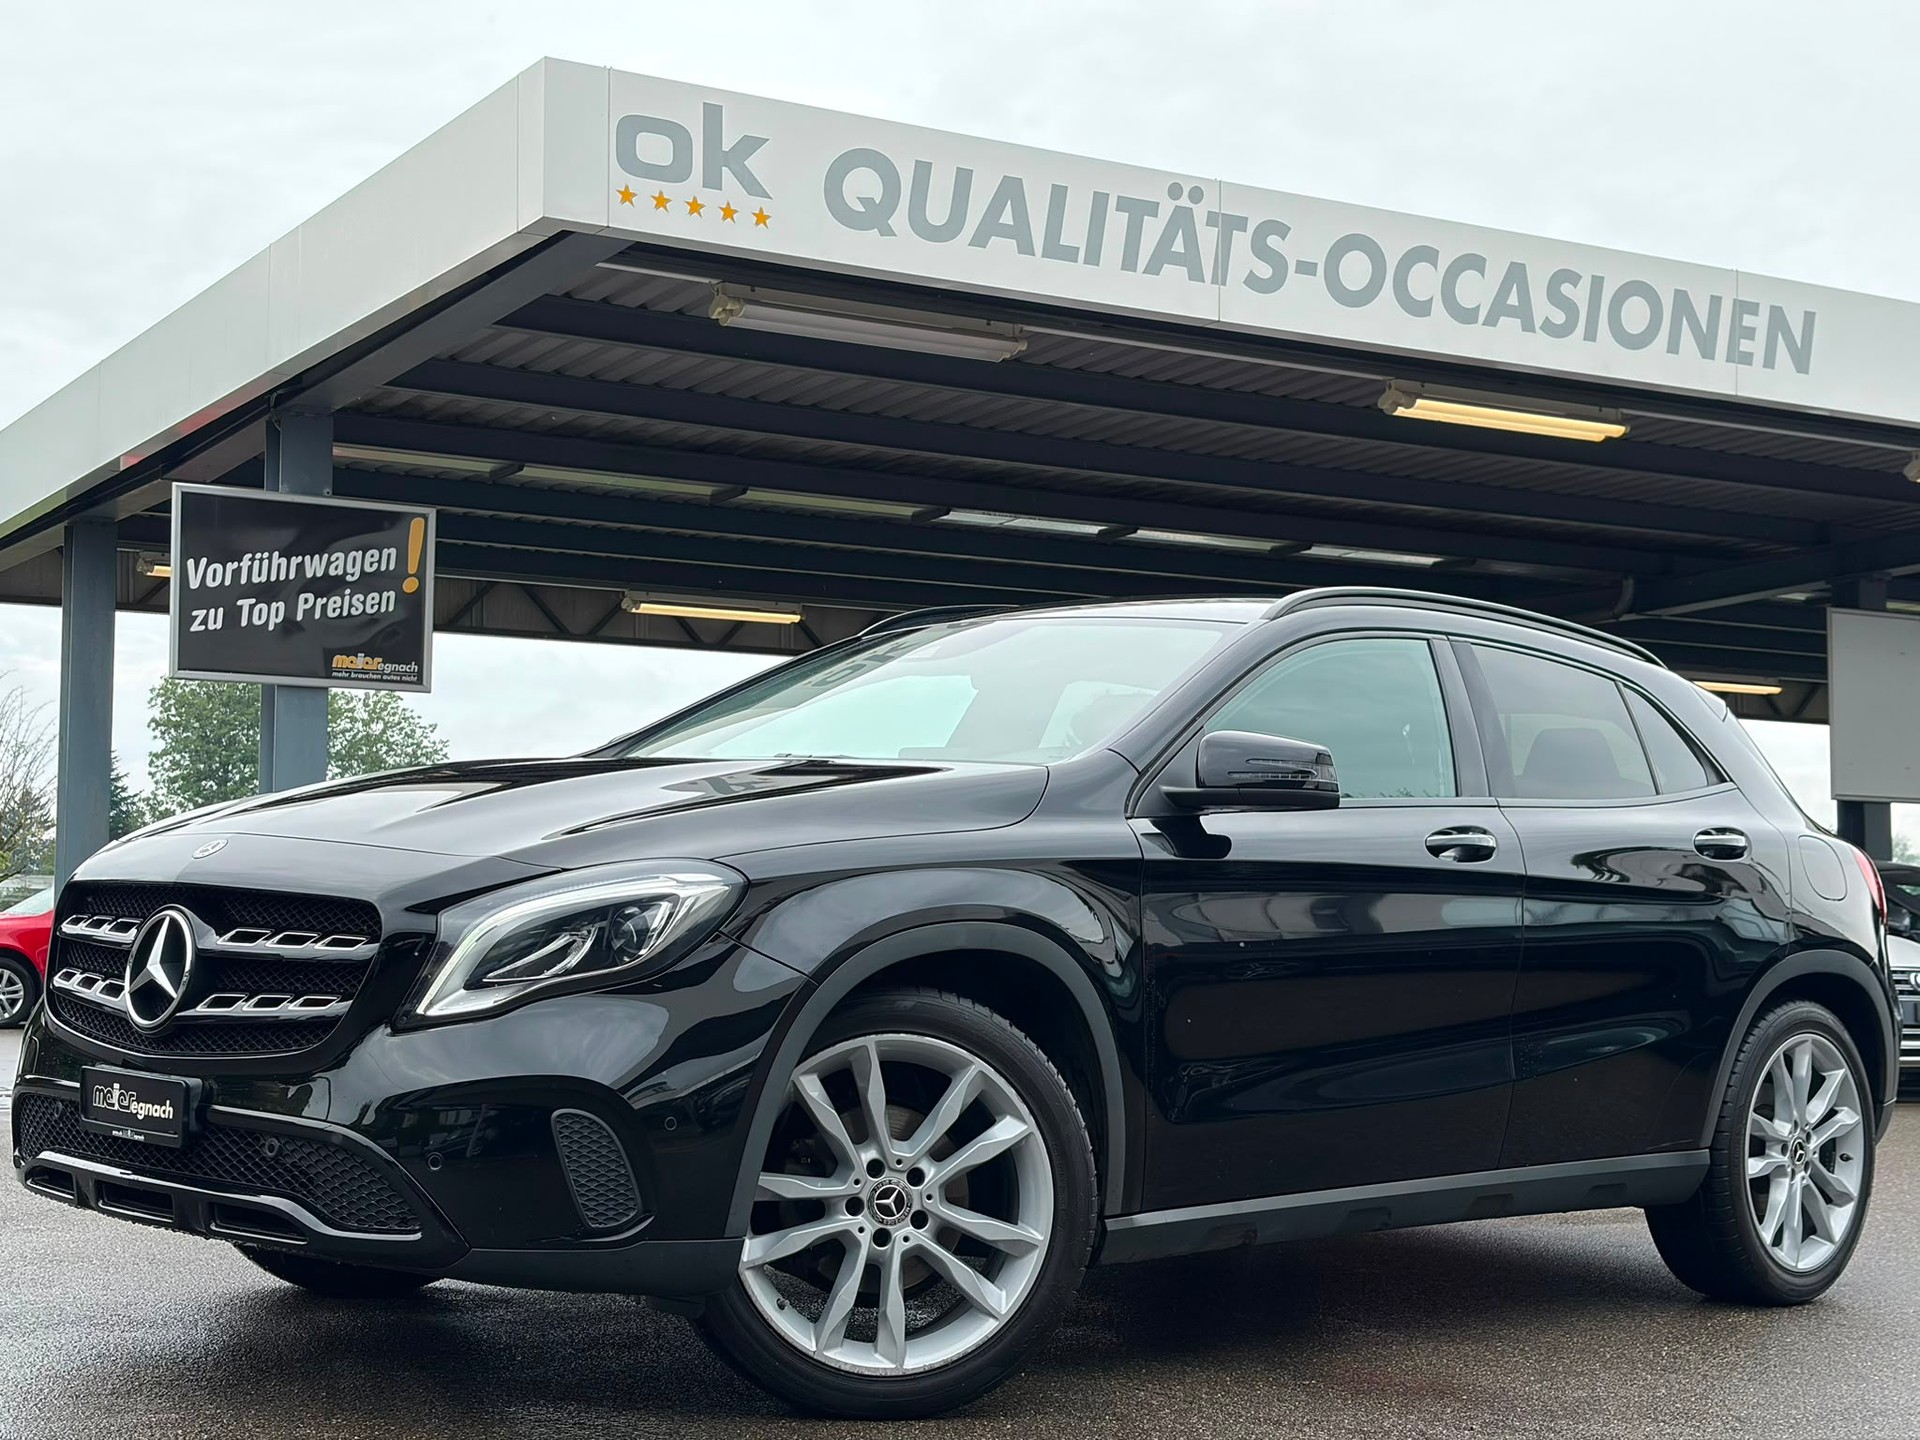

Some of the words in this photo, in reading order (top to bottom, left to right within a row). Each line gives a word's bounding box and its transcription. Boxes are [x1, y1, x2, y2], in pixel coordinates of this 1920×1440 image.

[615, 101, 773, 200] ok
[823, 146, 1817, 376] QUALITÄTS-OCCASIONEN
[186, 546, 398, 590] Vorführwagen
[189, 606, 224, 632] zu
[236, 597, 286, 631] Top
[296, 588, 397, 621] Preisen
